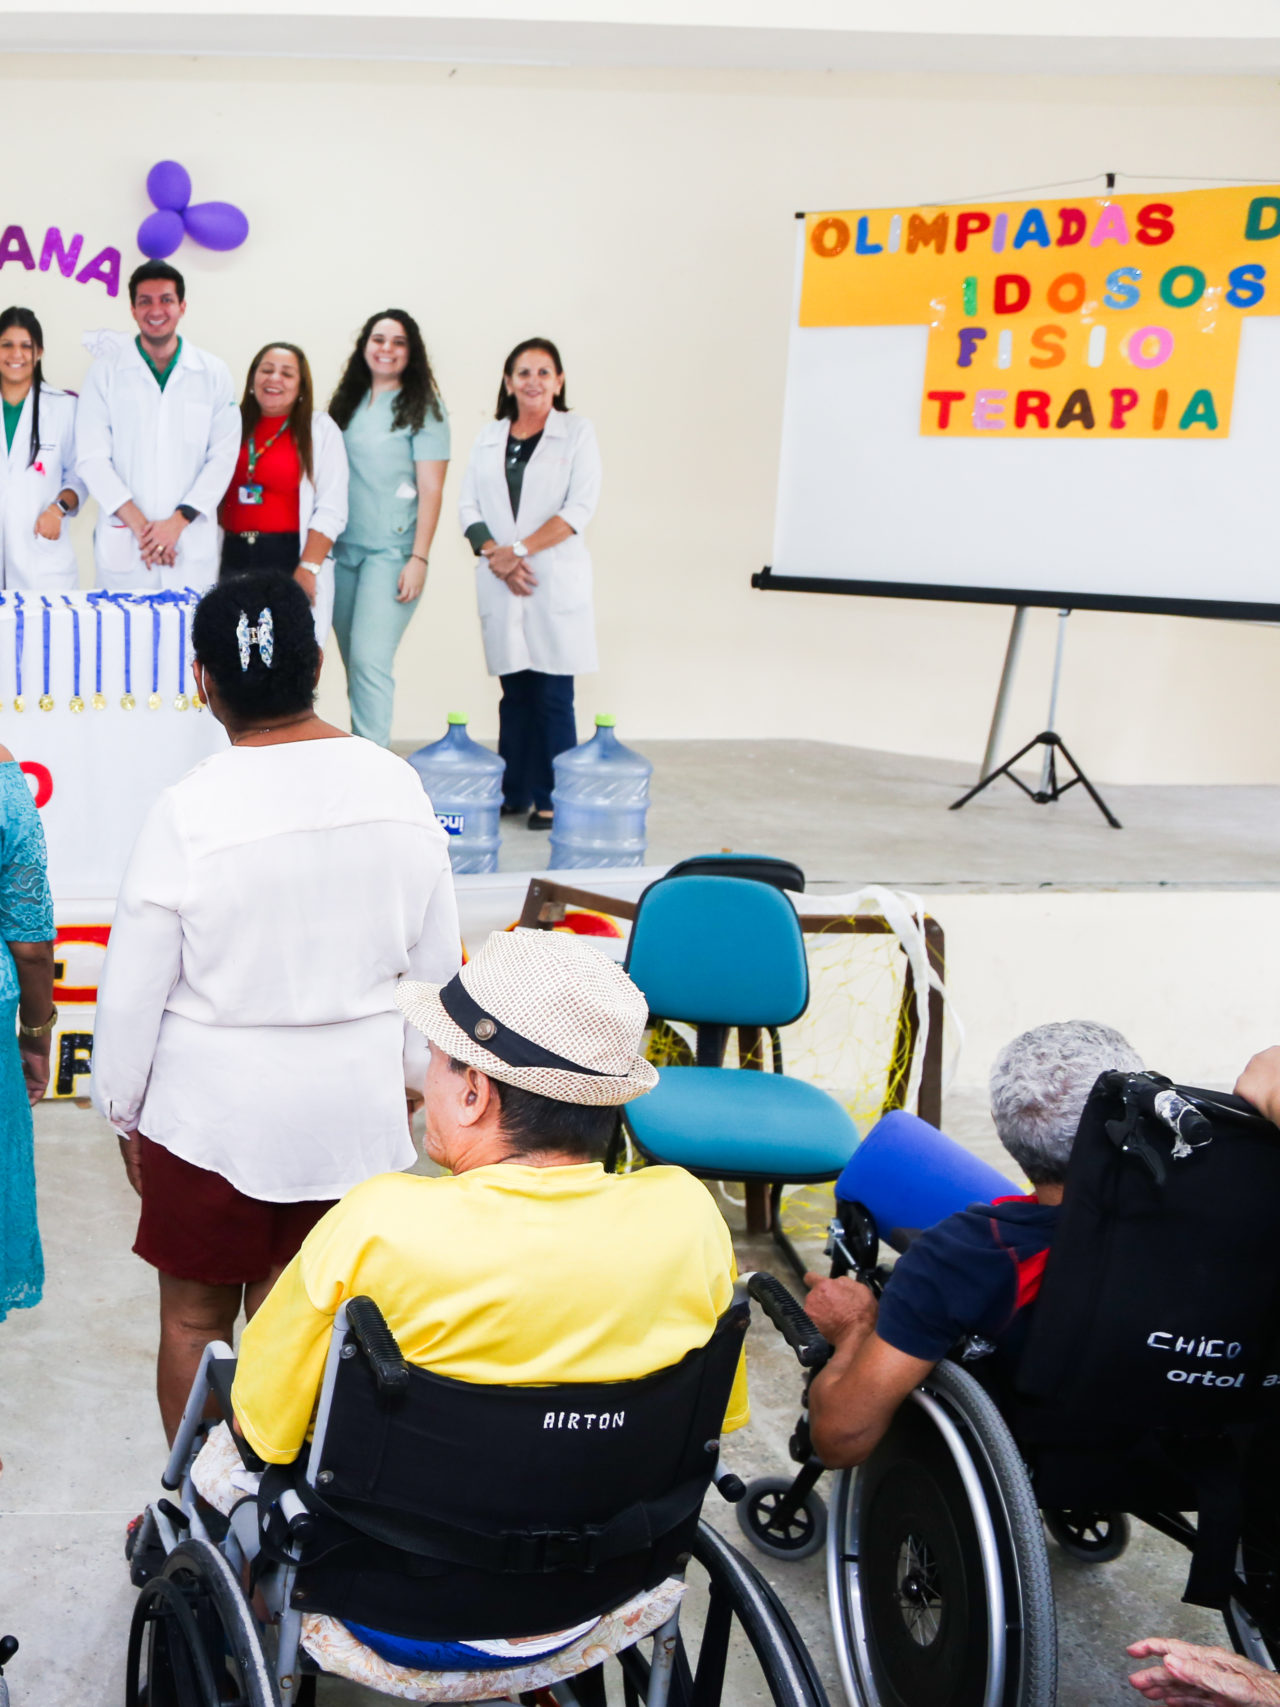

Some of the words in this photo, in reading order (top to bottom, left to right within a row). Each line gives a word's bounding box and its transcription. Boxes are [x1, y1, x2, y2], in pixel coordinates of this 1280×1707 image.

[810, 203, 1175, 258] OLIMPIADAS
[962, 264, 1266, 317] IDOSOS
[957, 325, 1175, 369] FISIO
[927, 388, 1219, 431] TERAPIA
[543, 1410, 625, 1430] AIRTON
